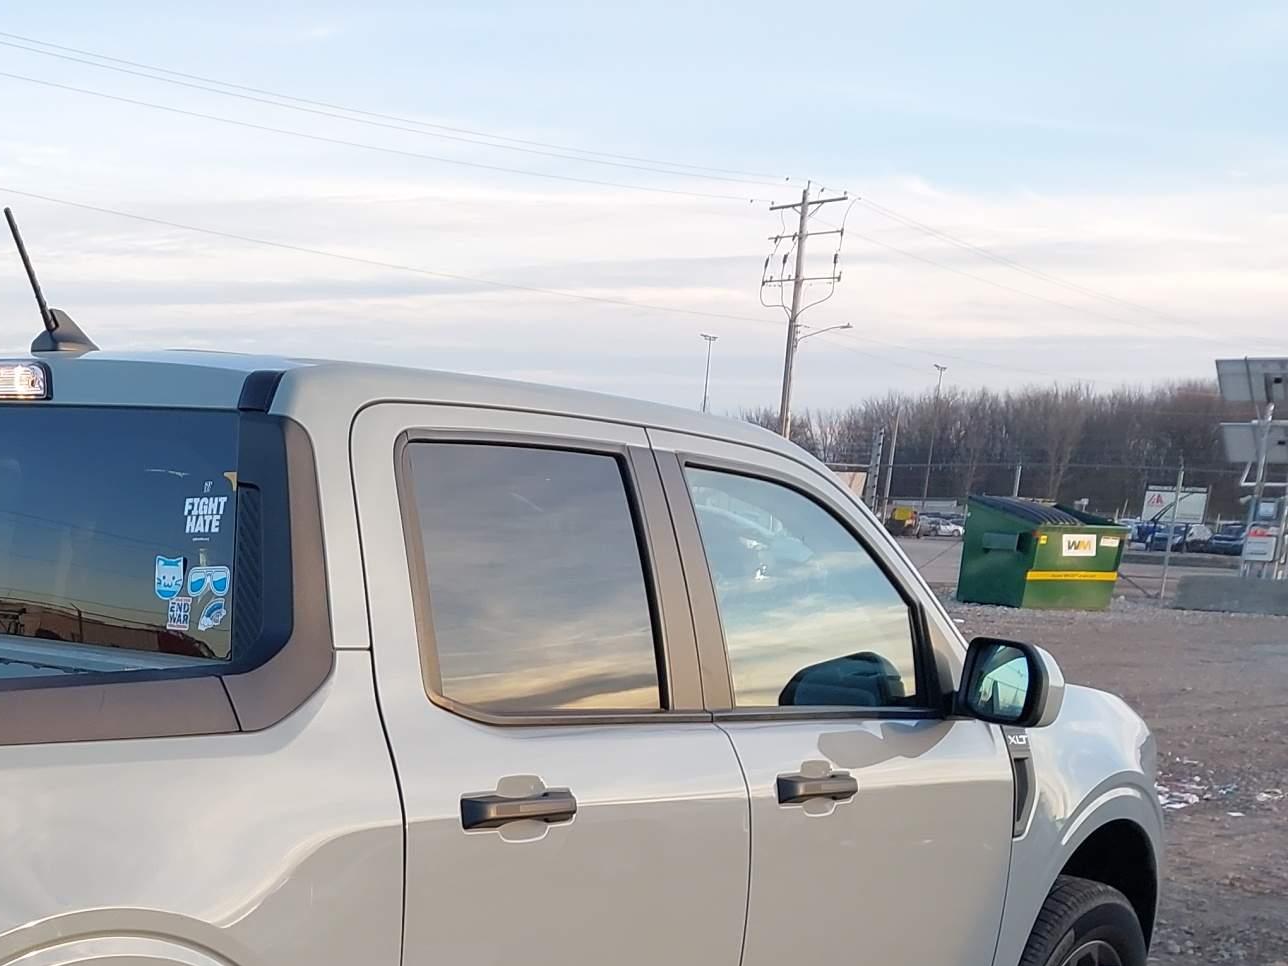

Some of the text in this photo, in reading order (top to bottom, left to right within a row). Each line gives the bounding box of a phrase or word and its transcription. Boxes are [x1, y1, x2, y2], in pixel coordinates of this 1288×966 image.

[183, 496, 228, 516] FIGHT
[185, 515, 221, 534] HATE
[1067, 540, 1091, 551] WM
[169, 602, 190, 614] END
[169, 613, 189, 625] WAR
[1007, 734, 1028, 745] XLT
